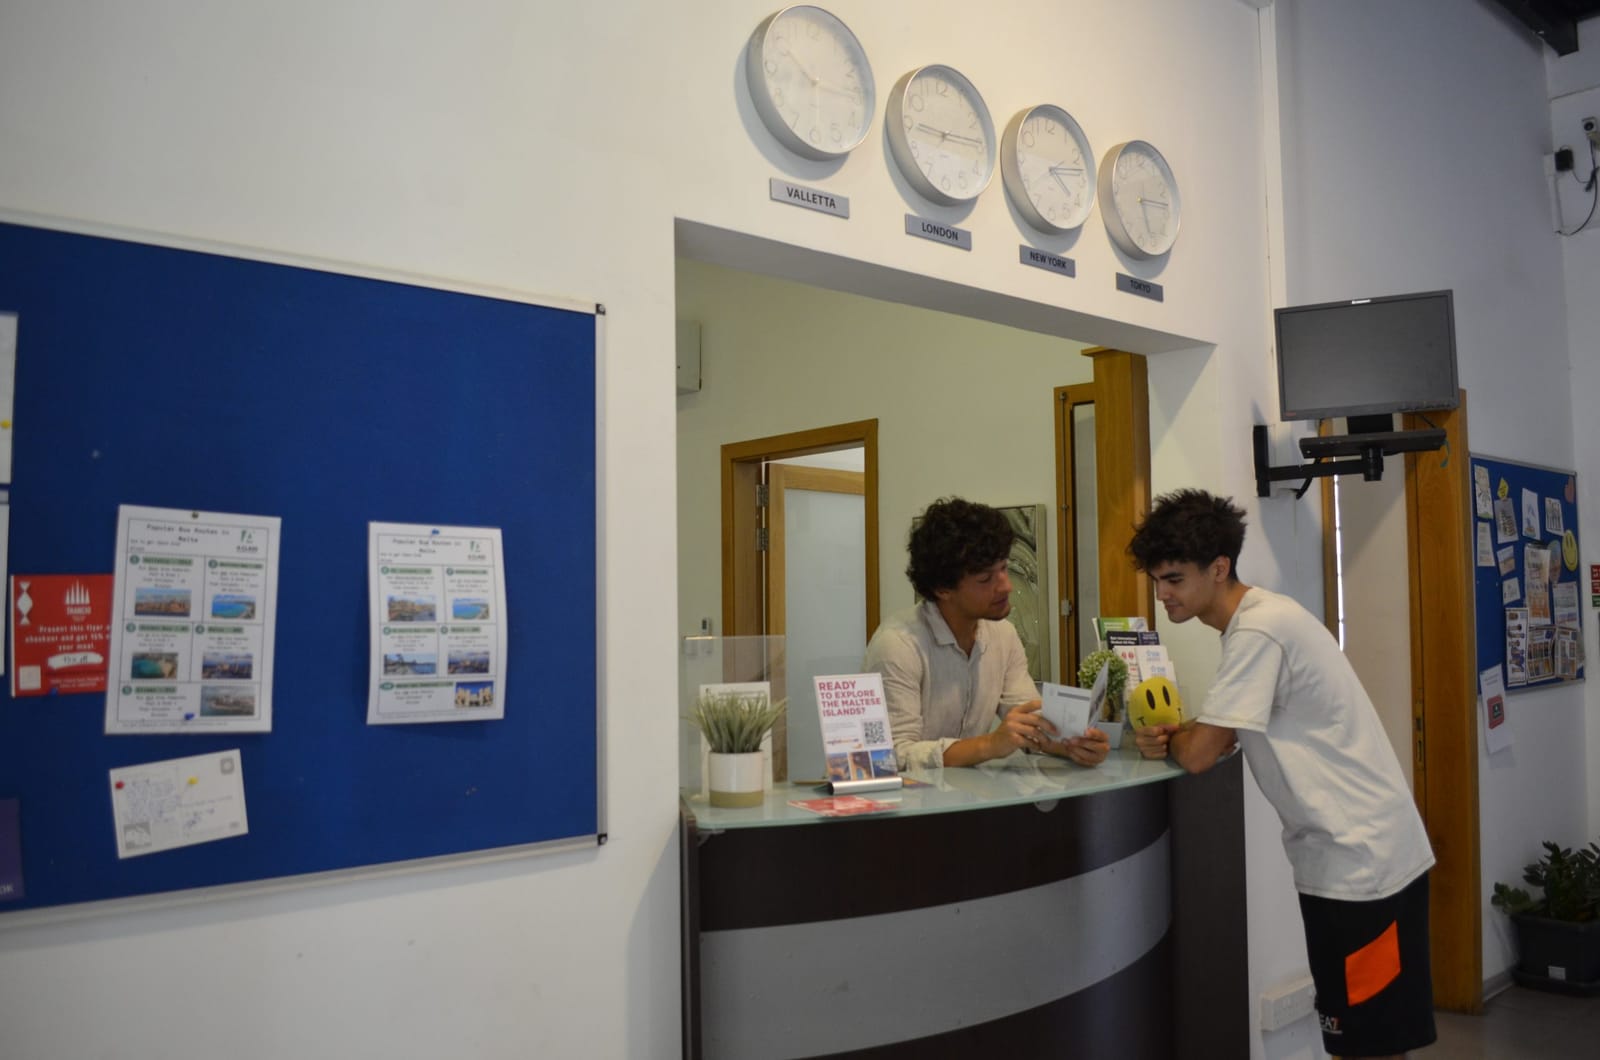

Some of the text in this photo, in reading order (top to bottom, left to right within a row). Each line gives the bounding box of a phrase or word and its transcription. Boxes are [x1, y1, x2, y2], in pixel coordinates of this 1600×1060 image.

[786, 186, 836, 209] VALLETTA
[921, 222, 959, 241] LONDON
[1029, 251, 1067, 270] NEW YORK
[1130, 279, 1152, 294] TOKYO
[60, 634, 74, 642] and
[818, 681, 857, 691] READY
[820, 690, 875, 700] TO EXPLORE
[822, 698, 881, 708] THE MALTESE
[822, 707, 866, 717] ISLANDS?
